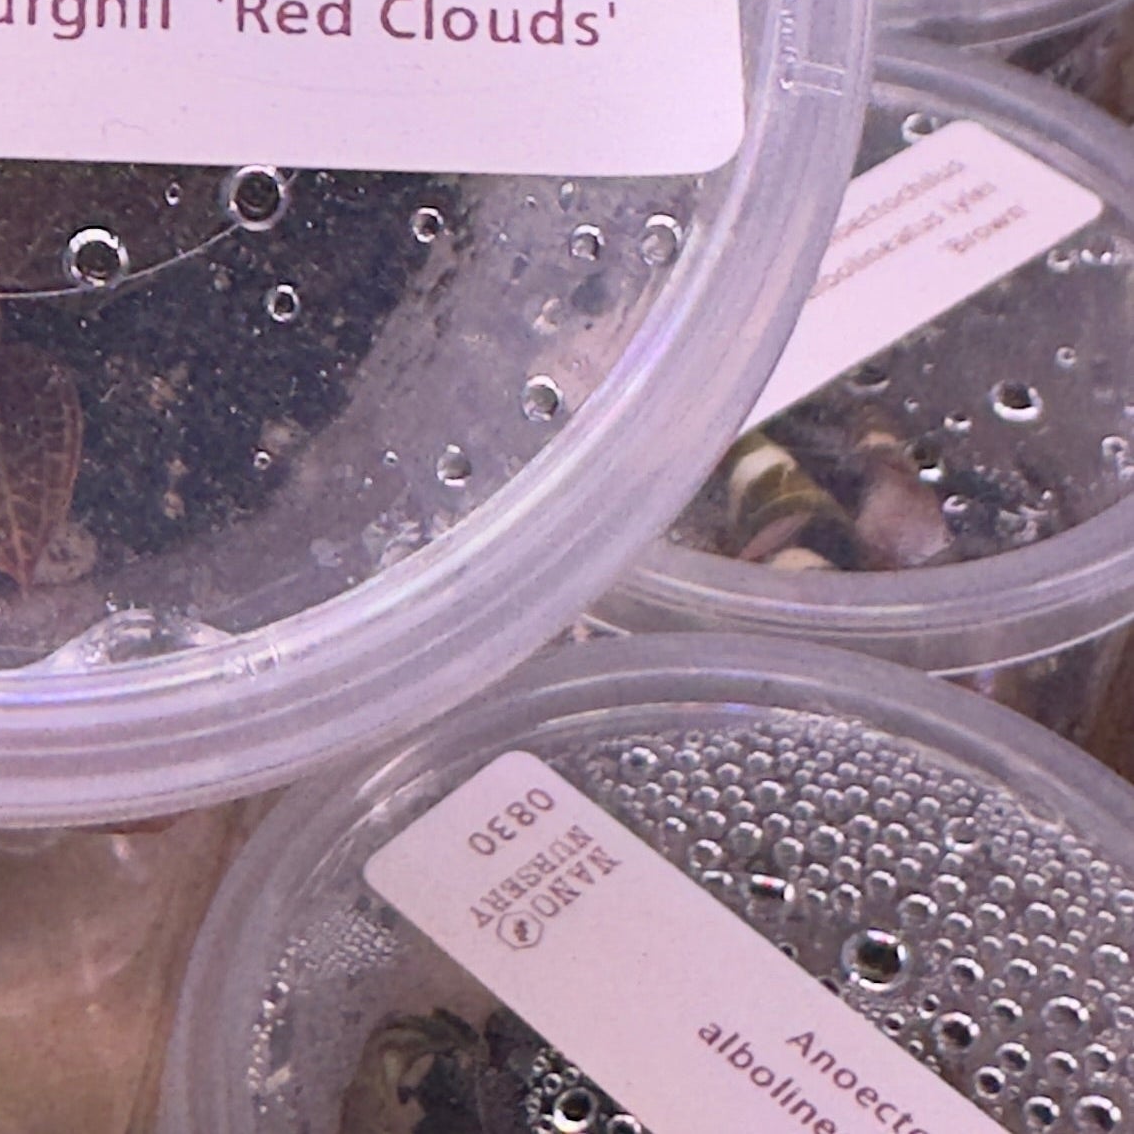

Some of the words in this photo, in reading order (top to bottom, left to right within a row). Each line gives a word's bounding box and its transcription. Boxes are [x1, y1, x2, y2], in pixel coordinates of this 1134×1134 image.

[468, 788, 555, 856] 0830
[469, 824, 594, 929] NURSERY
[529, 846, 623, 918] NANO
[785, 1031, 930, 1134] Anoect
